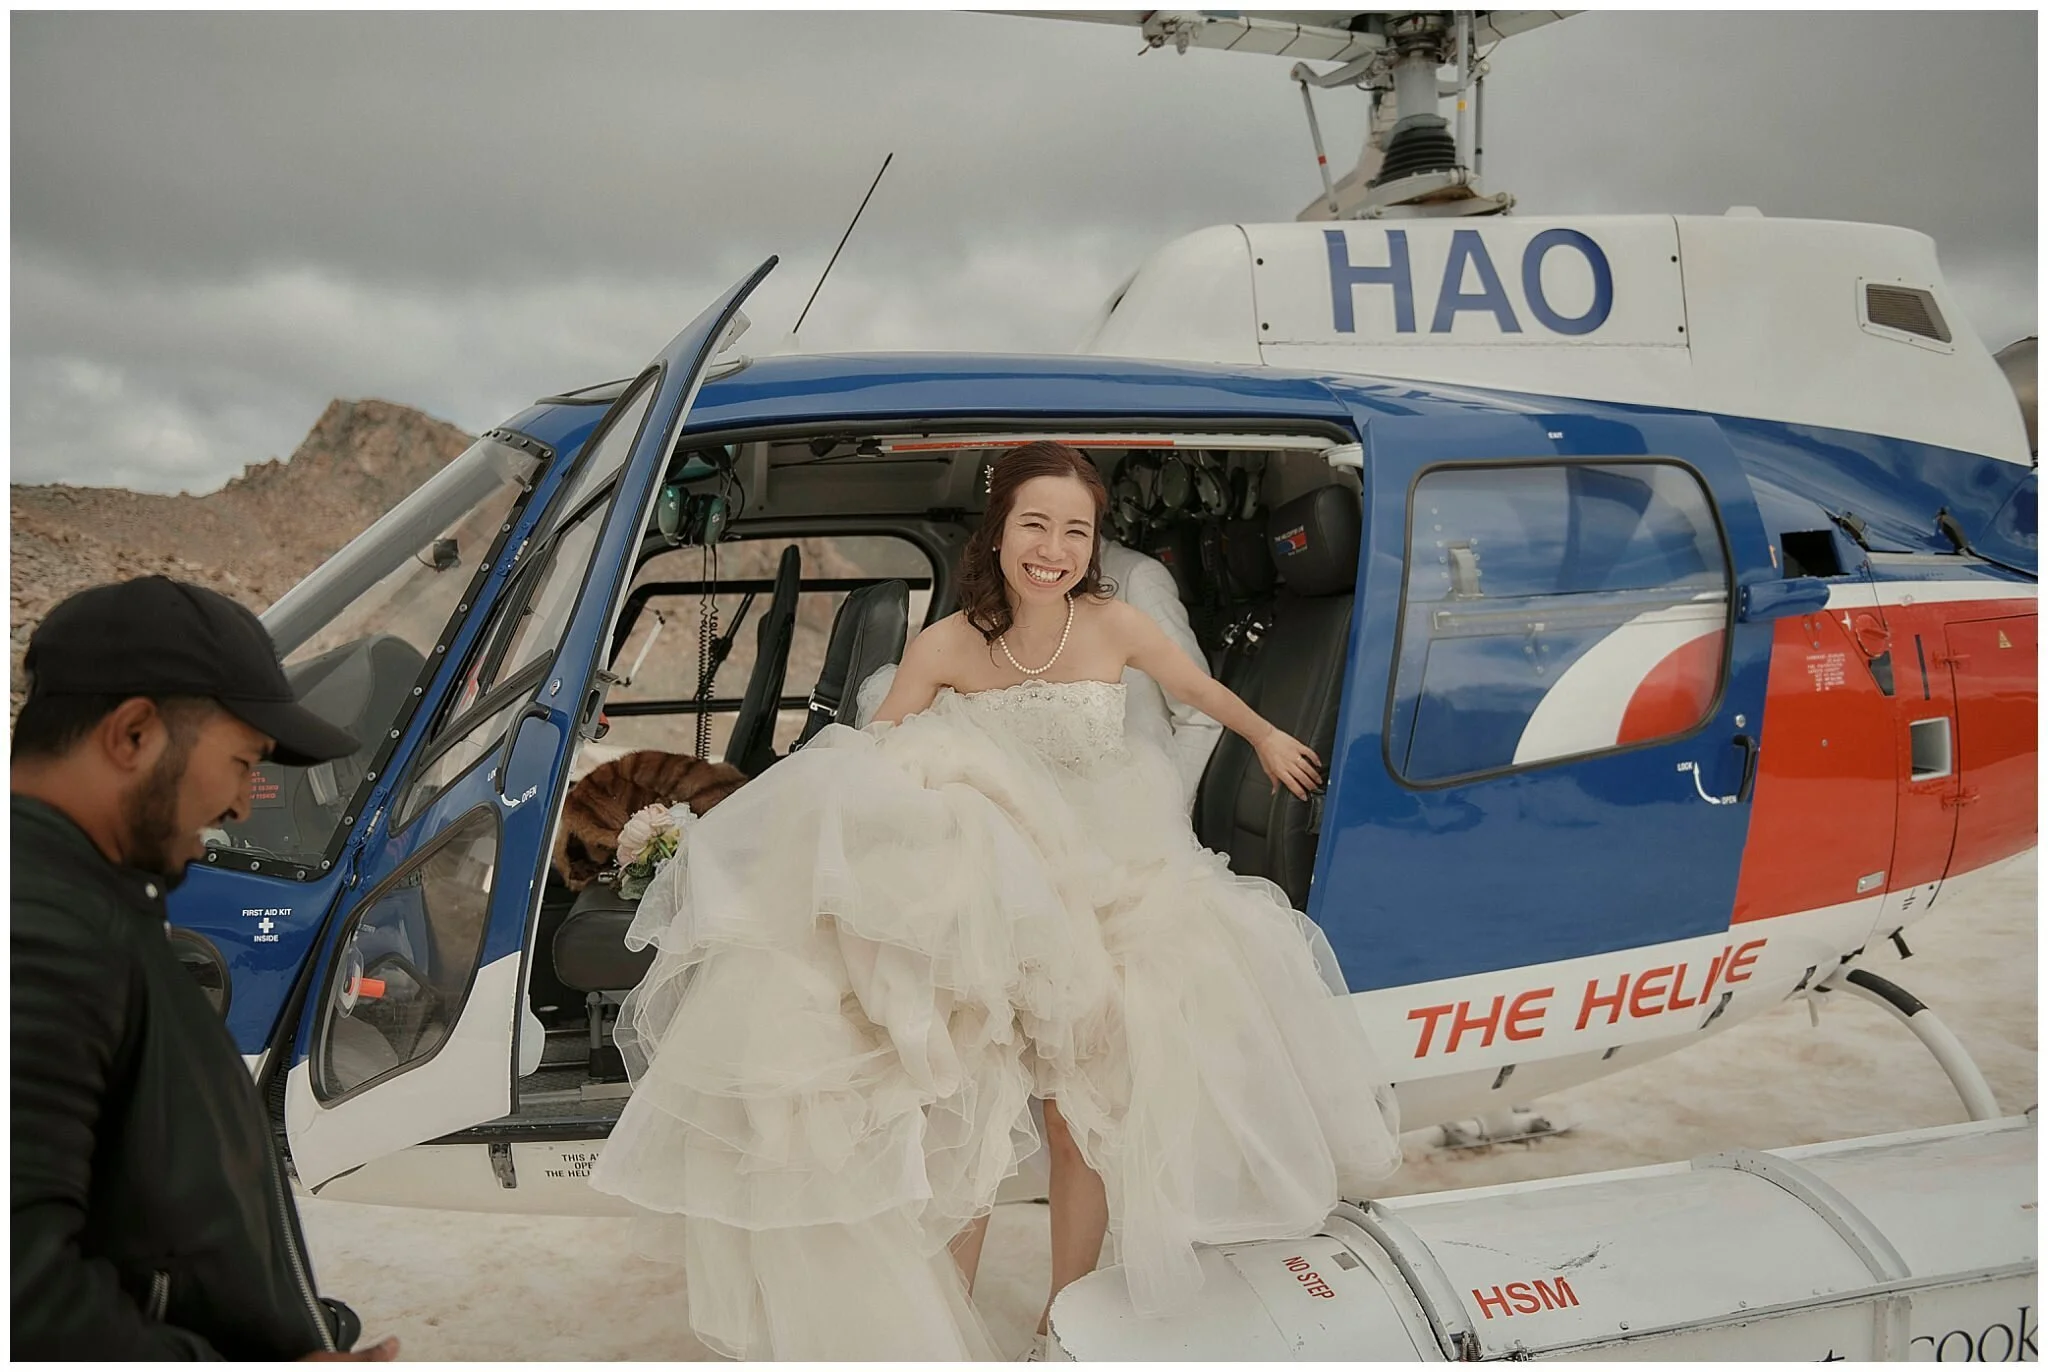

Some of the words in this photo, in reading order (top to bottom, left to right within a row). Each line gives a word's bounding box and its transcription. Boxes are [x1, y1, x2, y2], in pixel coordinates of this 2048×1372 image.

[1323, 228, 1613, 335] HAO
[1677, 761, 1692, 771] LOCK
[521, 784, 537, 803] OPEN
[1722, 795, 1737, 804] OPEN
[254, 934, 279, 942] INSIDE
[1407, 987, 1555, 1058] THE
[561, 1153, 585, 1162] THIS
[574, 1162, 593, 1170] OPE
[1282, 1255, 1311, 1272] NO
[1297, 1269, 1335, 1300] STEP
[1472, 1276, 1580, 1319] HSM
